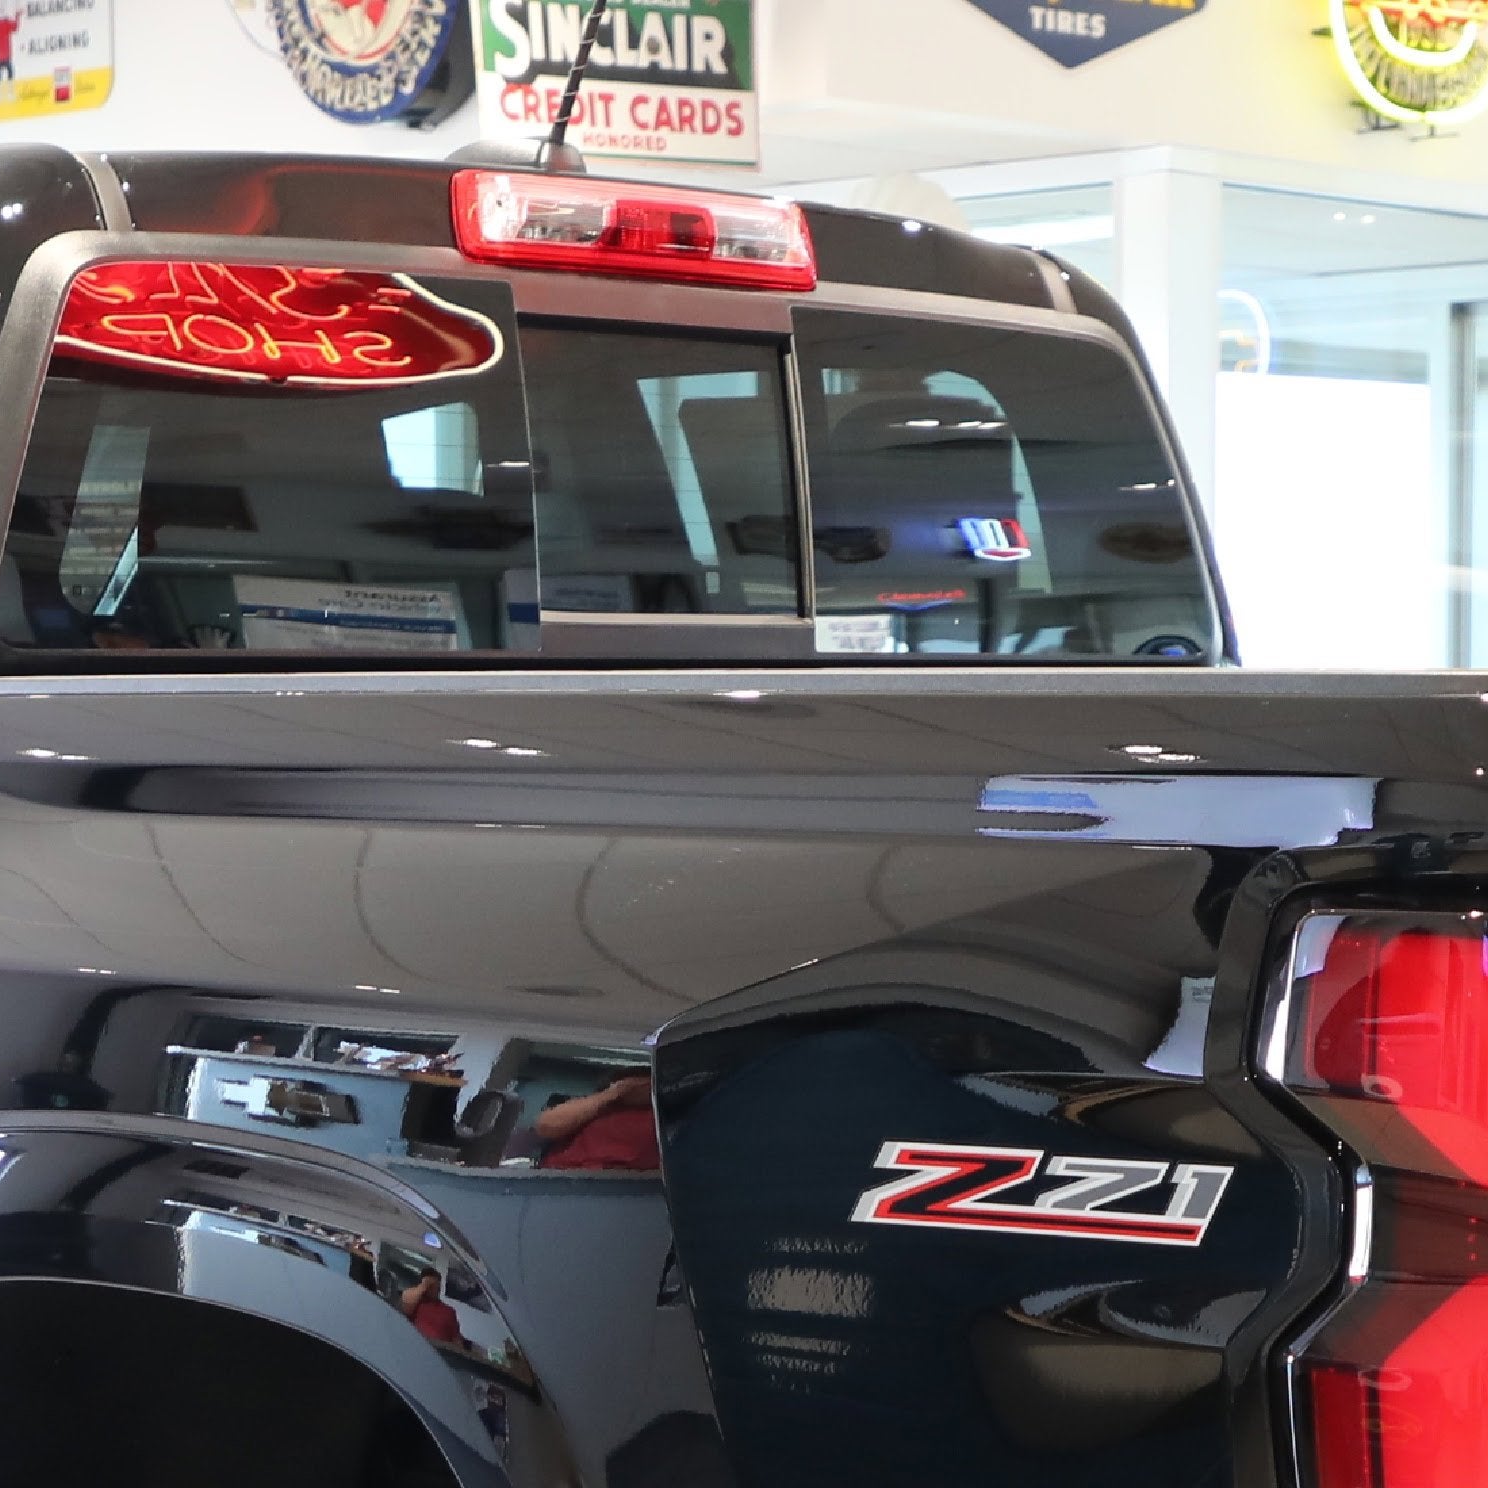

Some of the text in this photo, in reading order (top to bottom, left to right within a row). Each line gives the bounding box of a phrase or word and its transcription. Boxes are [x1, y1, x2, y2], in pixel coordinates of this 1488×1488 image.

[28, 30, 90, 55] ALIGNING
[488, 0, 728, 80] SINCLAIR
[1029, 5, 1106, 39] TIRES
[500, 82, 745, 137] CREDIT CARDS
[583, 131, 666, 152] HONORED
[849, 1141, 1234, 1247] Z71
